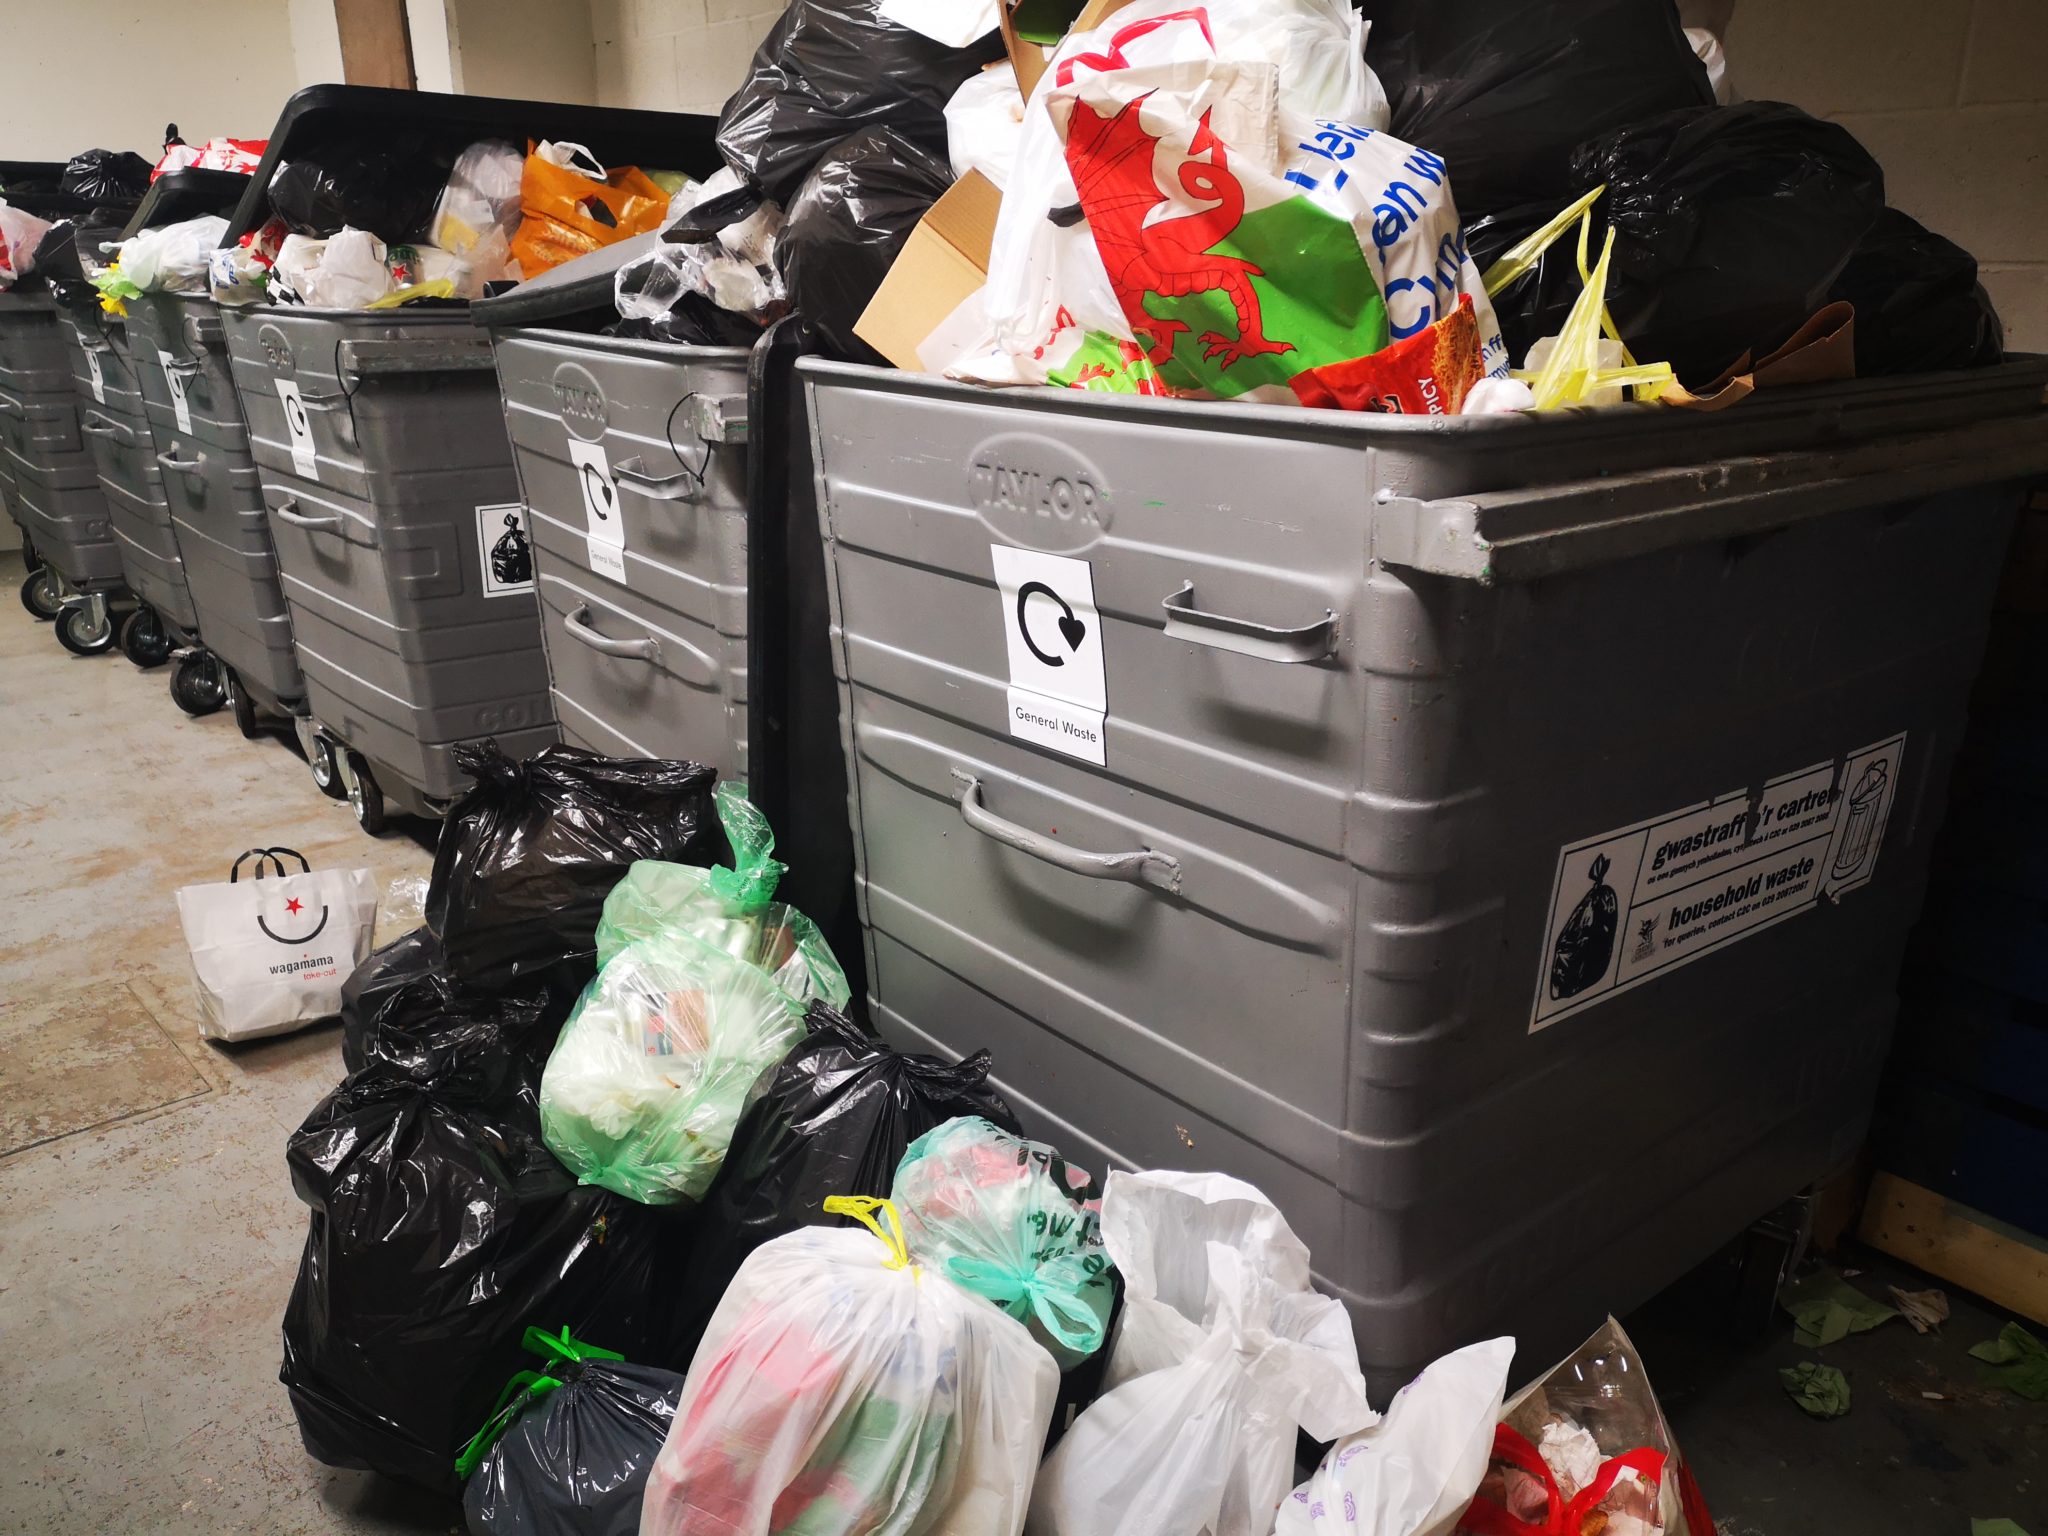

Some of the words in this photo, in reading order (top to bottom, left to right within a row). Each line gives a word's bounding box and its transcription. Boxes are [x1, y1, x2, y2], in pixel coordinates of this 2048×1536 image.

[1418, 377, 1445, 415] PICY
[976, 461, 1101, 527] TAYLOR
[1015, 706, 1059, 732] General
[1062, 720, 1097, 744] Waste
[1667, 873, 1764, 931] household
[1765, 856, 1815, 890] waste
[1662, 936, 1676, 950] for
[1708, 910, 1736, 931] contact
[1736, 902, 1752, 918] C2C
[269, 954, 334, 976] wagamama
[303, 968, 337, 981] take-out
